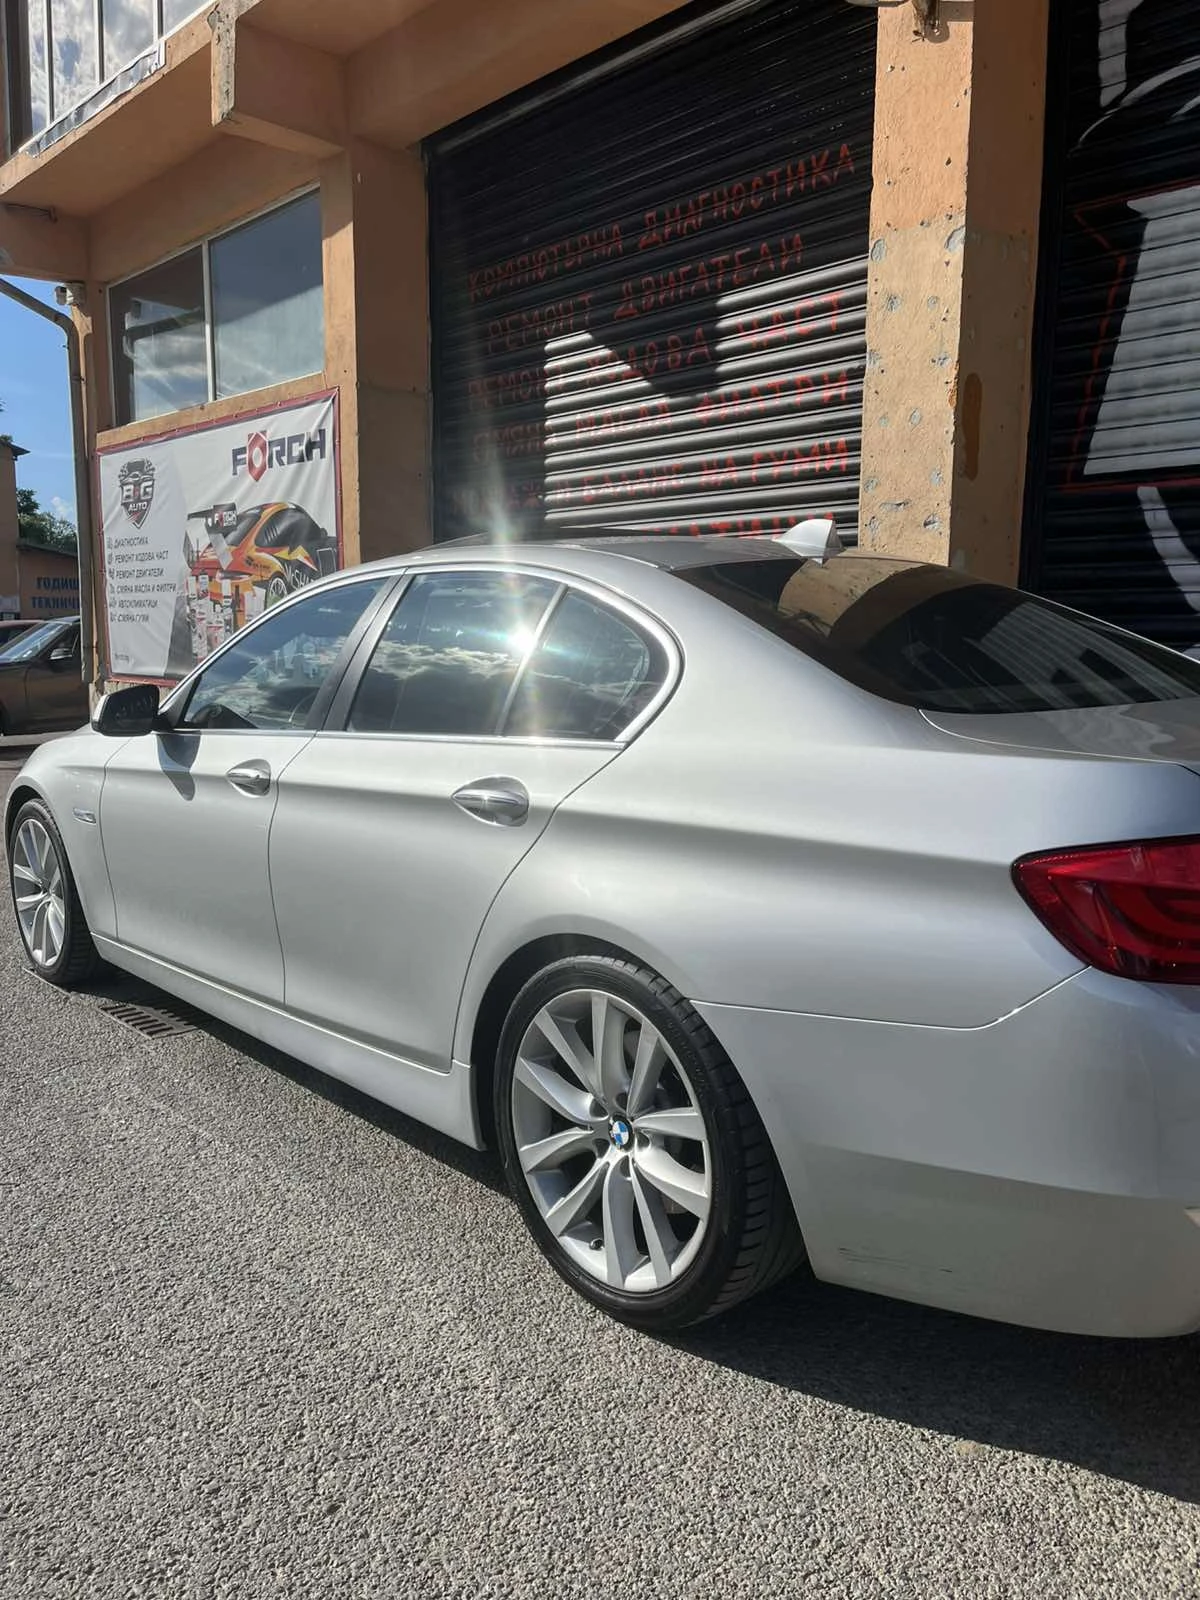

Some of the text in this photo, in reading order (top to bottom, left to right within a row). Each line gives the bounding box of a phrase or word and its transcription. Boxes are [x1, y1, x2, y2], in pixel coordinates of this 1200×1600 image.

[638, 143, 855, 249] ДИАГНОСТИКА
[488, 233, 803, 355] РЕМОНТ ДВИГАТЕЛИ
[735, 290, 844, 348] ЧАСТ
[752, 437, 848, 483] ГУМИ
[129, 501, 148, 511] AUTO
